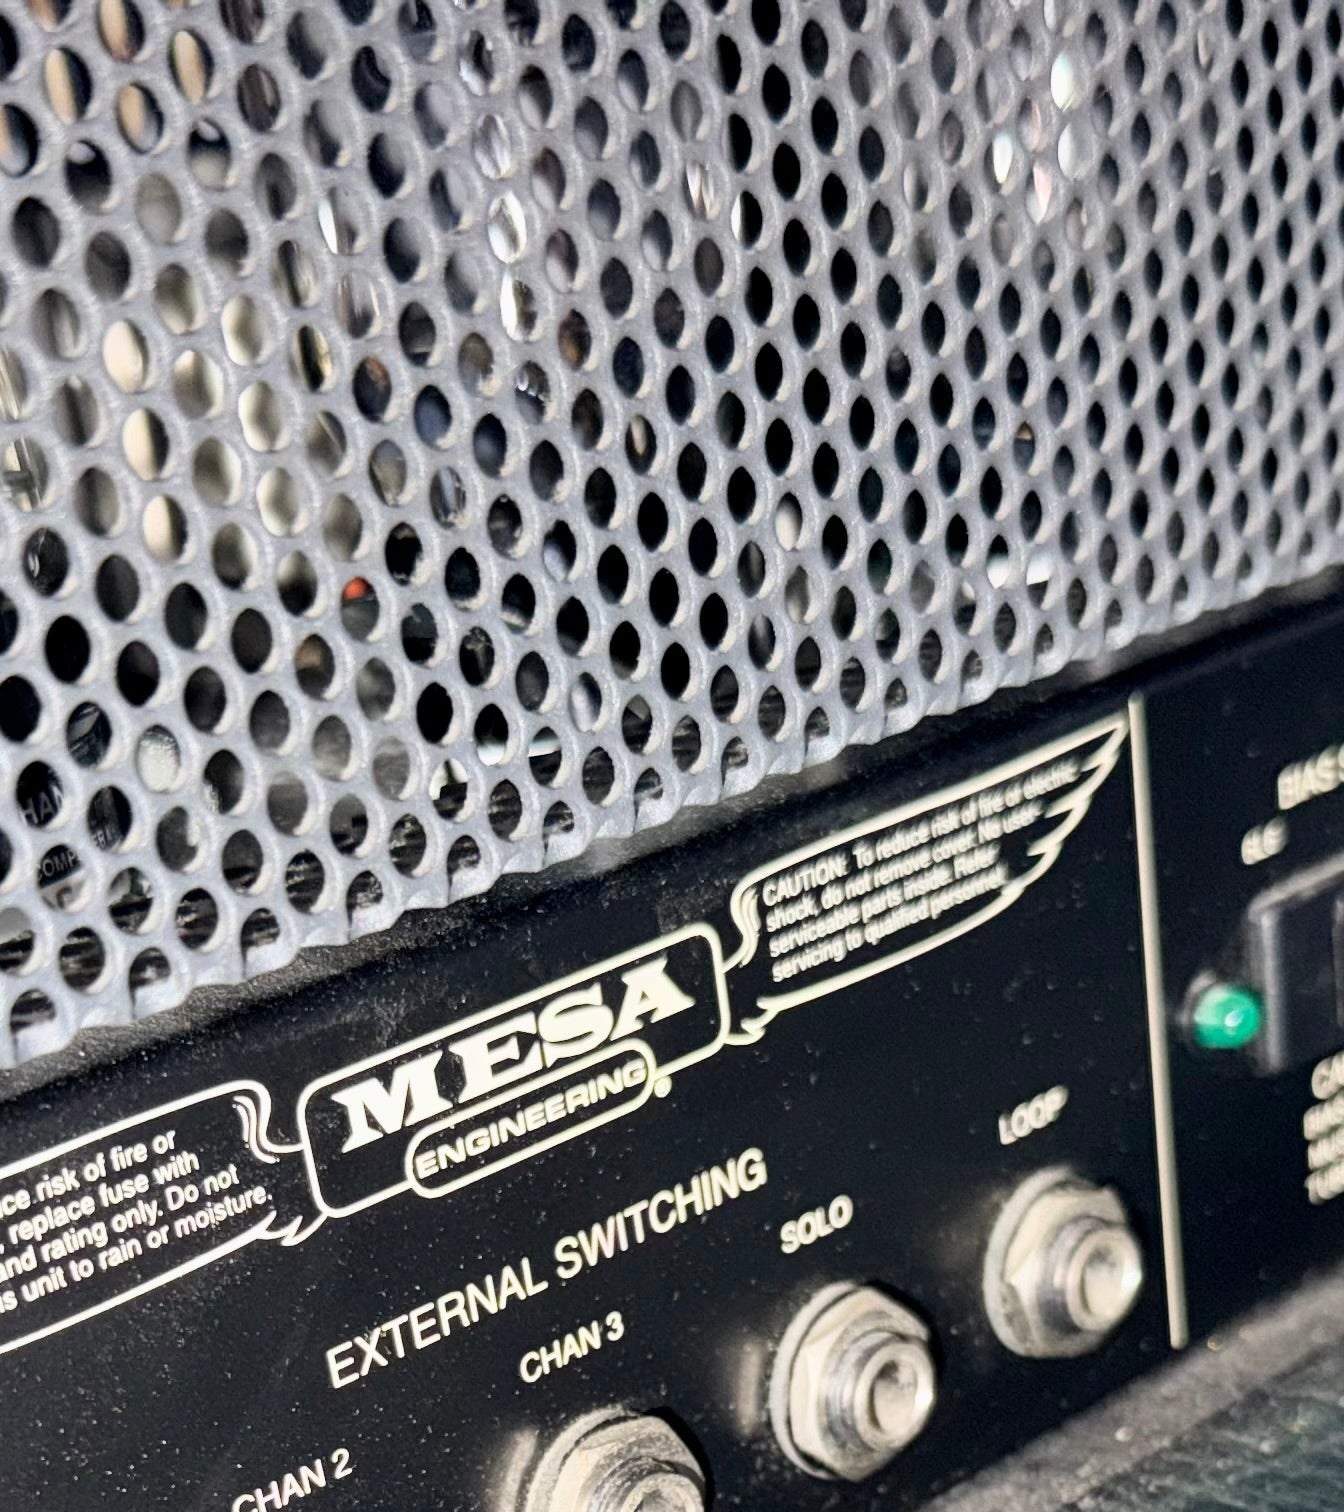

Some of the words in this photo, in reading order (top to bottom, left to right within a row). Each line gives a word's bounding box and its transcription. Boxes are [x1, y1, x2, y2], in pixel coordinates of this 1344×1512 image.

[766, 893, 821, 932] shock,
[821, 882, 845, 910] do
[845, 870, 874, 899] not
[873, 844, 933, 887] remove
[978, 815, 1003, 844] No
[852, 840, 876, 869] To
[876, 821, 931, 861] reduce
[931, 804, 960, 838] risk
[769, 904, 862, 957] serviceable
[861, 883, 903, 923] parts
[772, 931, 846, 982] servicing
[845, 925, 865, 951] to
[864, 896, 931, 946] qualified
[332, 956, 696, 1153] MESA
[413, 1058, 647, 1180] ENGINEERING
[998, 1085, 1070, 1146] LOOP
[8, 1196, 95, 1245] replace
[99, 1174, 149, 1207] fuse
[153, 1151, 199, 1185] with
[35, 1168, 80, 1202] risk
[83, 1152, 107, 1182] of
[109, 1142, 148, 1172] fire
[152, 1130, 176, 1154] or
[21, 1267, 68, 1302] unit
[69, 1259, 94, 1282] to
[98, 1238, 143, 1270] rain
[146, 1224, 170, 1250] or
[174, 1186, 273, 1238] moisture.
[40, 1222, 108, 1263] rating
[111, 1200, 163, 1233] only.
[165, 1184, 199, 1211] Do
[204, 1164, 240, 1195] not
[780, 1195, 854, 1254] SOLO
[325, 1257, 548, 1389] EXTERNAL
[554, 1147, 768, 1280] SWITCHING
[519, 1320, 601, 1383] CHAN
[606, 1311, 624, 1343] 3
[331, 1448, 353, 1480] 2
